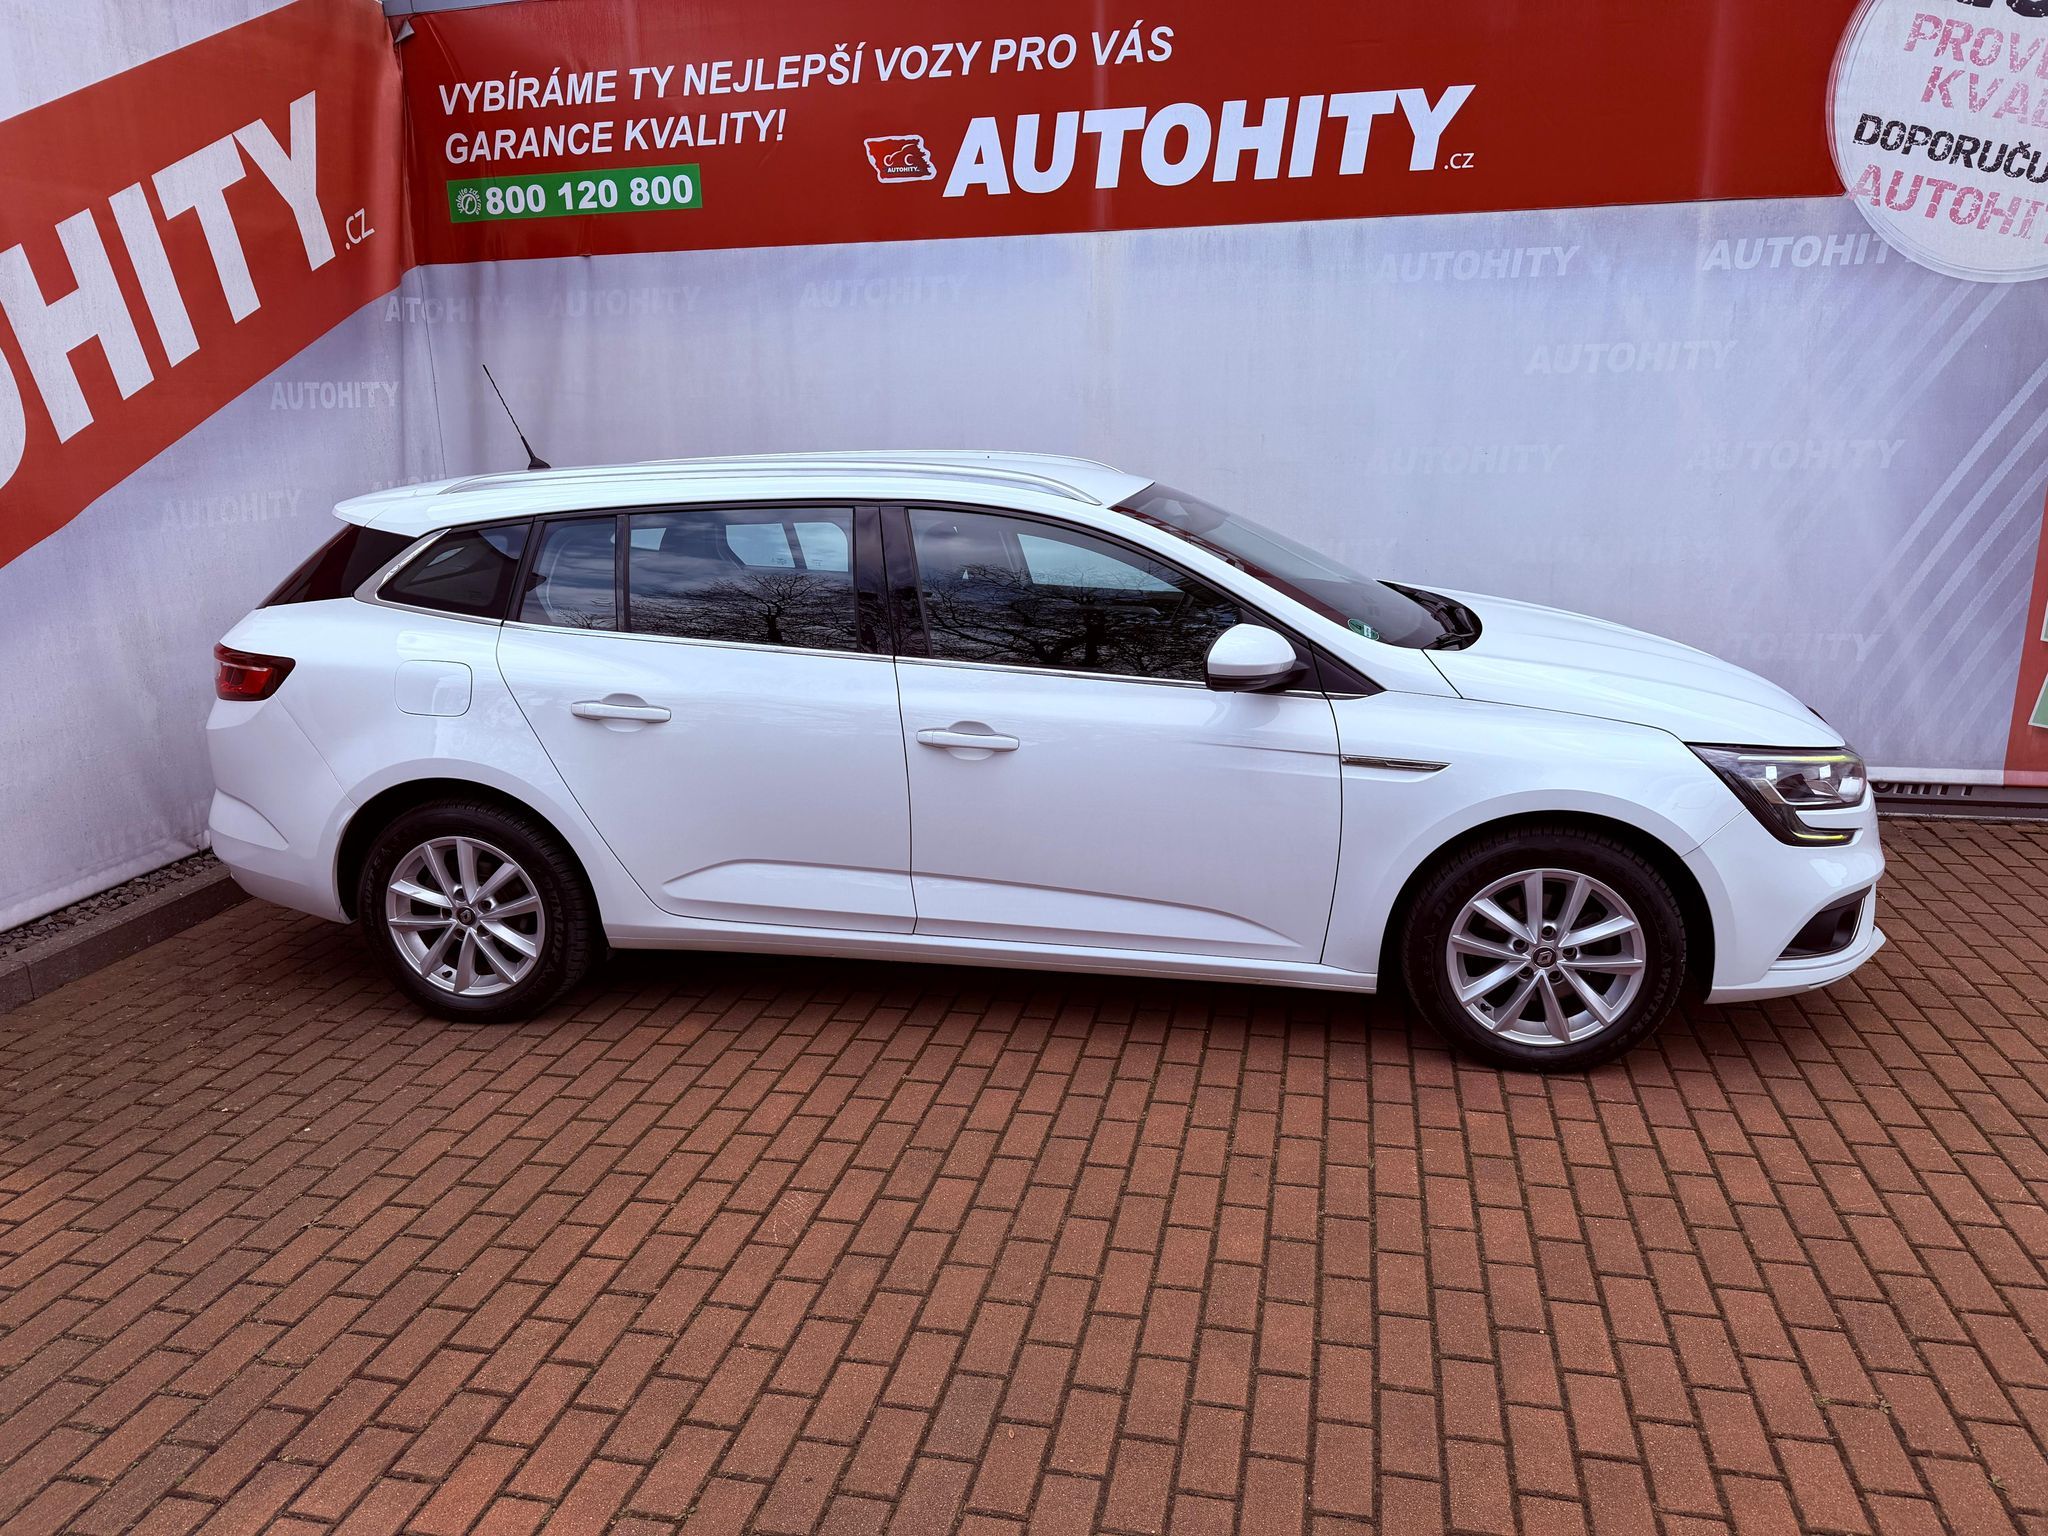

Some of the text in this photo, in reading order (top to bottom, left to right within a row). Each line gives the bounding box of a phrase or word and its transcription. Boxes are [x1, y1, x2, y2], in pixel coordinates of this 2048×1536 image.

[439, 19, 1174, 115] VYBÍRÁME TY NEJLEPŠÍ VOZY PRO VÁS
[445, 109, 786, 164] GARANCE KVALITY!
[486, 174, 693, 215] 800 120 800
[1376, 245, 1580, 283] AUTOHITY
[1525, 340, 1737, 375] AUTOHITY
[270, 381, 399, 411] AUTOHITY
